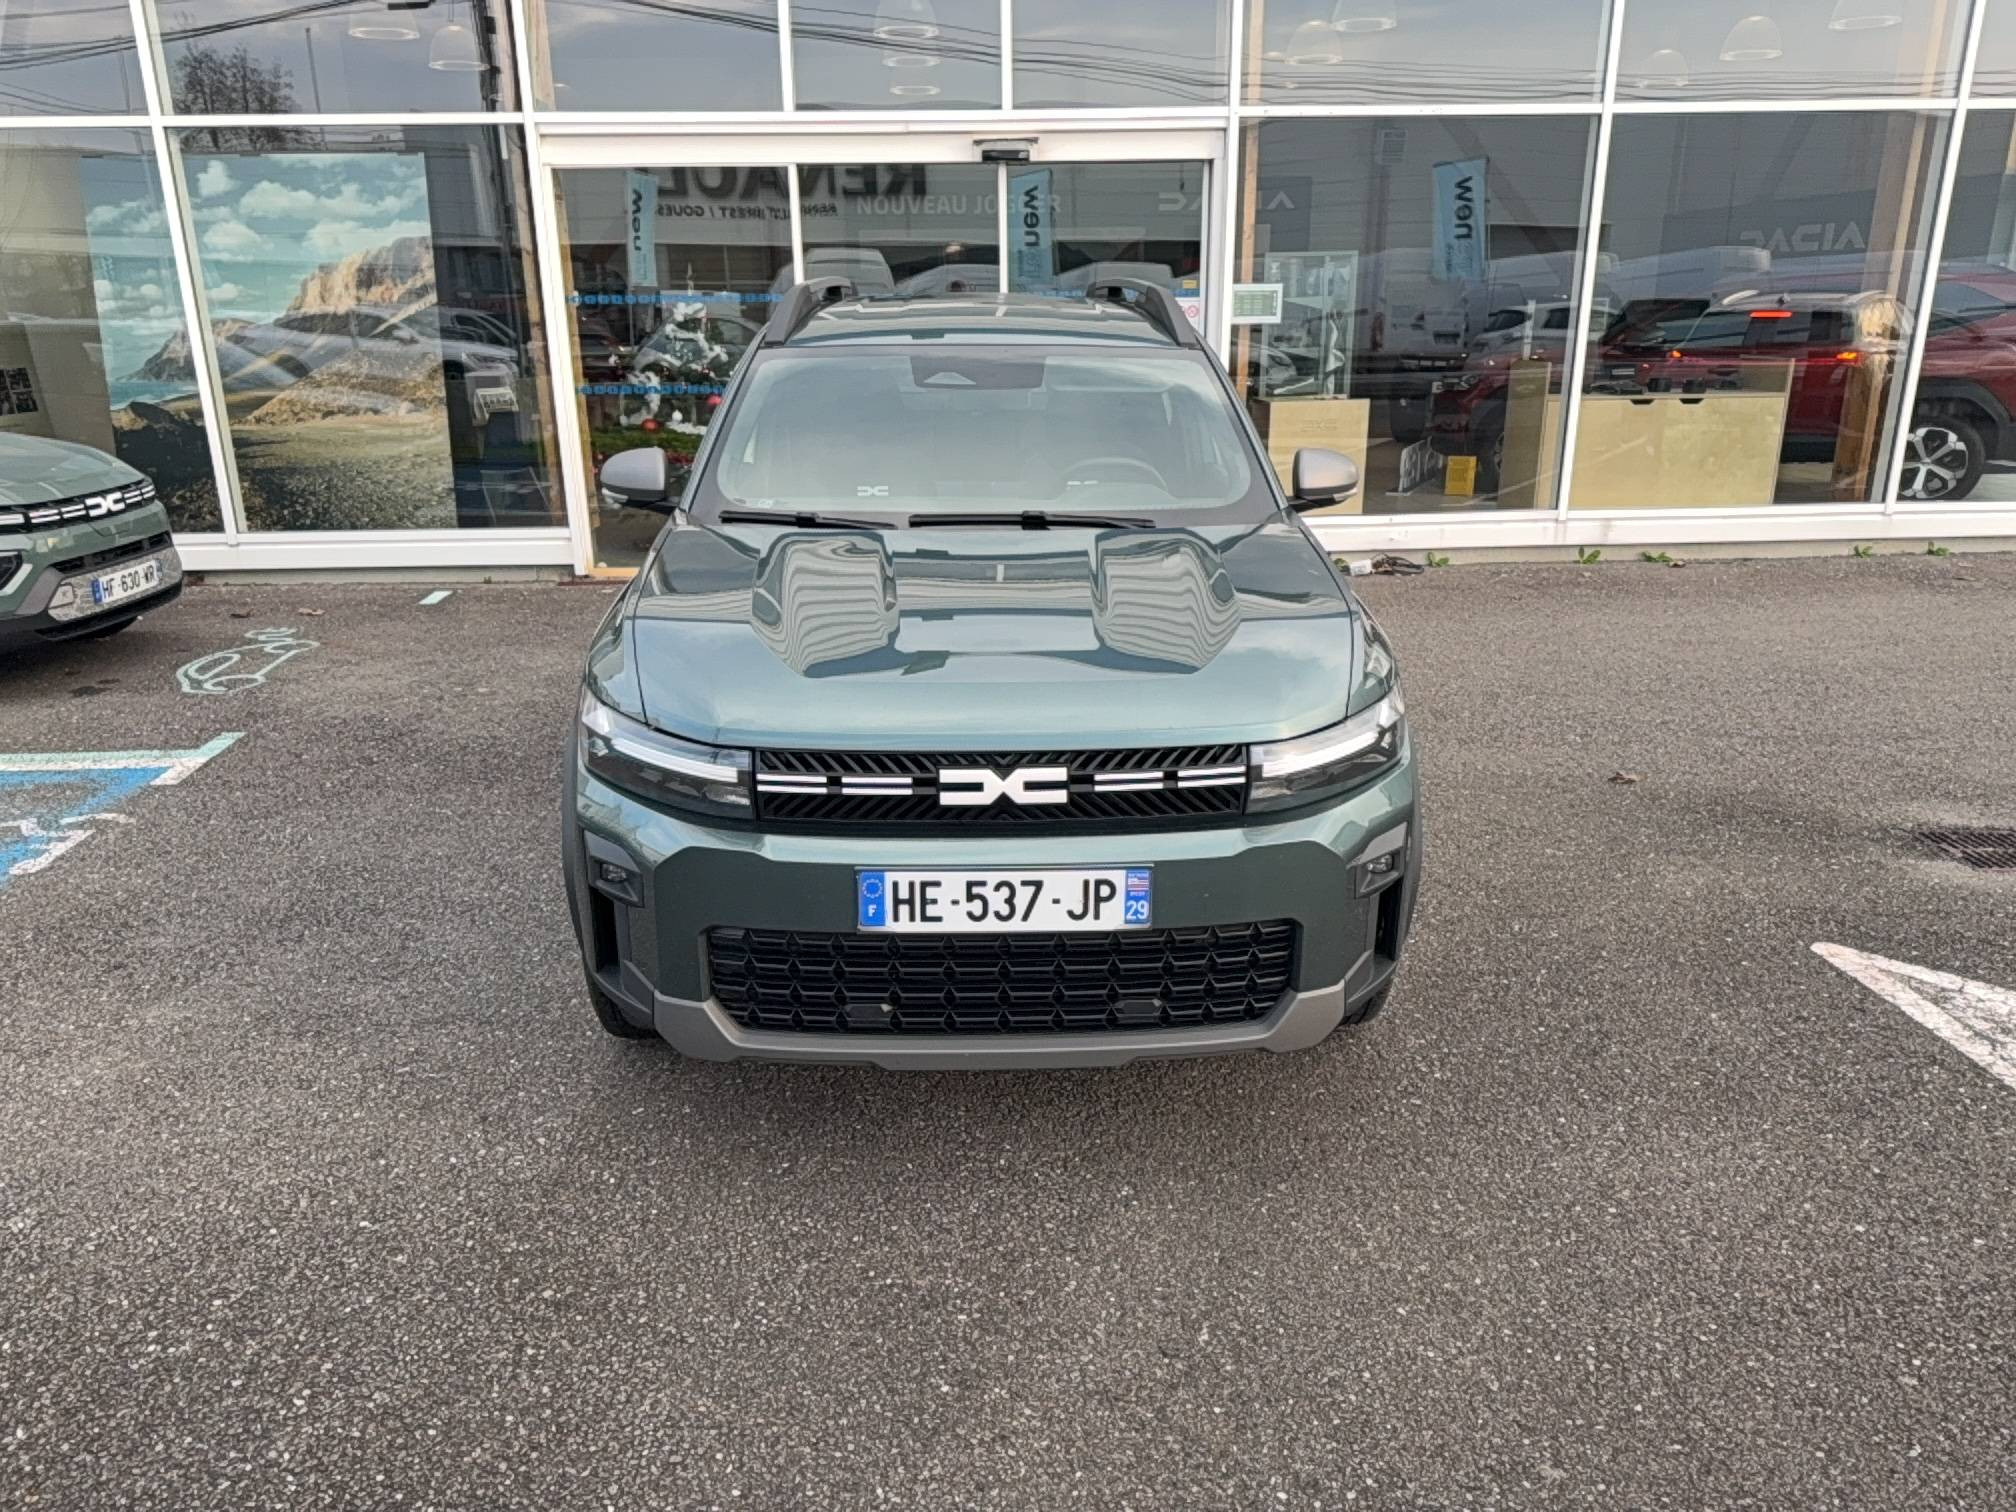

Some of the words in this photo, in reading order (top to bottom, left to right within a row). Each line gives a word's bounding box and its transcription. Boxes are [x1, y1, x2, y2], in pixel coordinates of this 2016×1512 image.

[856, 194, 966, 216] NOUVEAU
[867, 904, 877, 917] F
[892, 878, 1117, 922] HE-537-JP
[1126, 900, 1149, 921] 29
